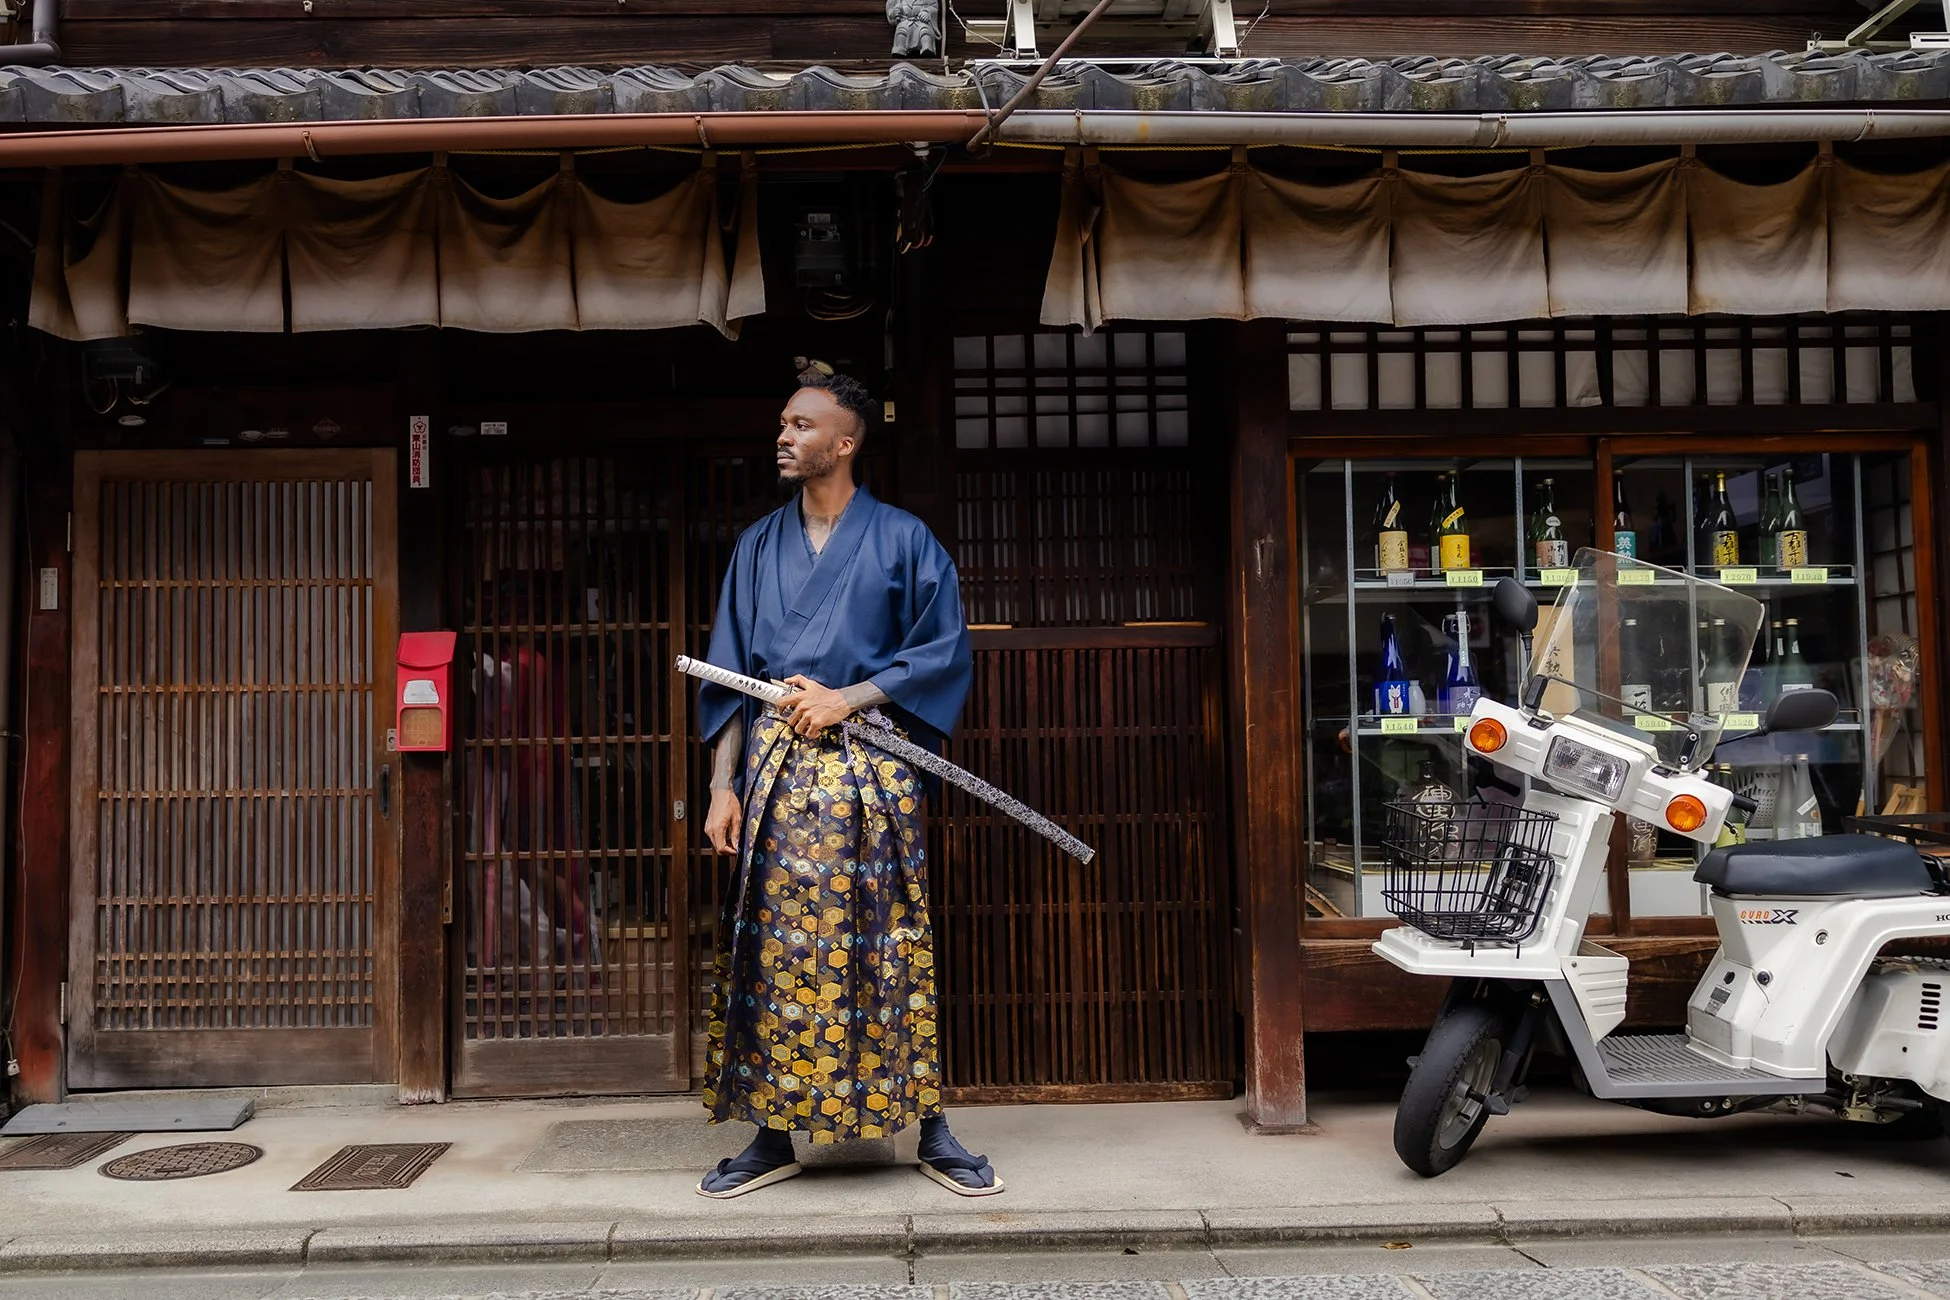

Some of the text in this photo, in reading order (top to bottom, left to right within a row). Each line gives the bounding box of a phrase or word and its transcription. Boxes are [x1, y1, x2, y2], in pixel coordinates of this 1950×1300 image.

[412, 434, 421, 484] 東山消防団員
[1770, 909, 1799, 924] X
